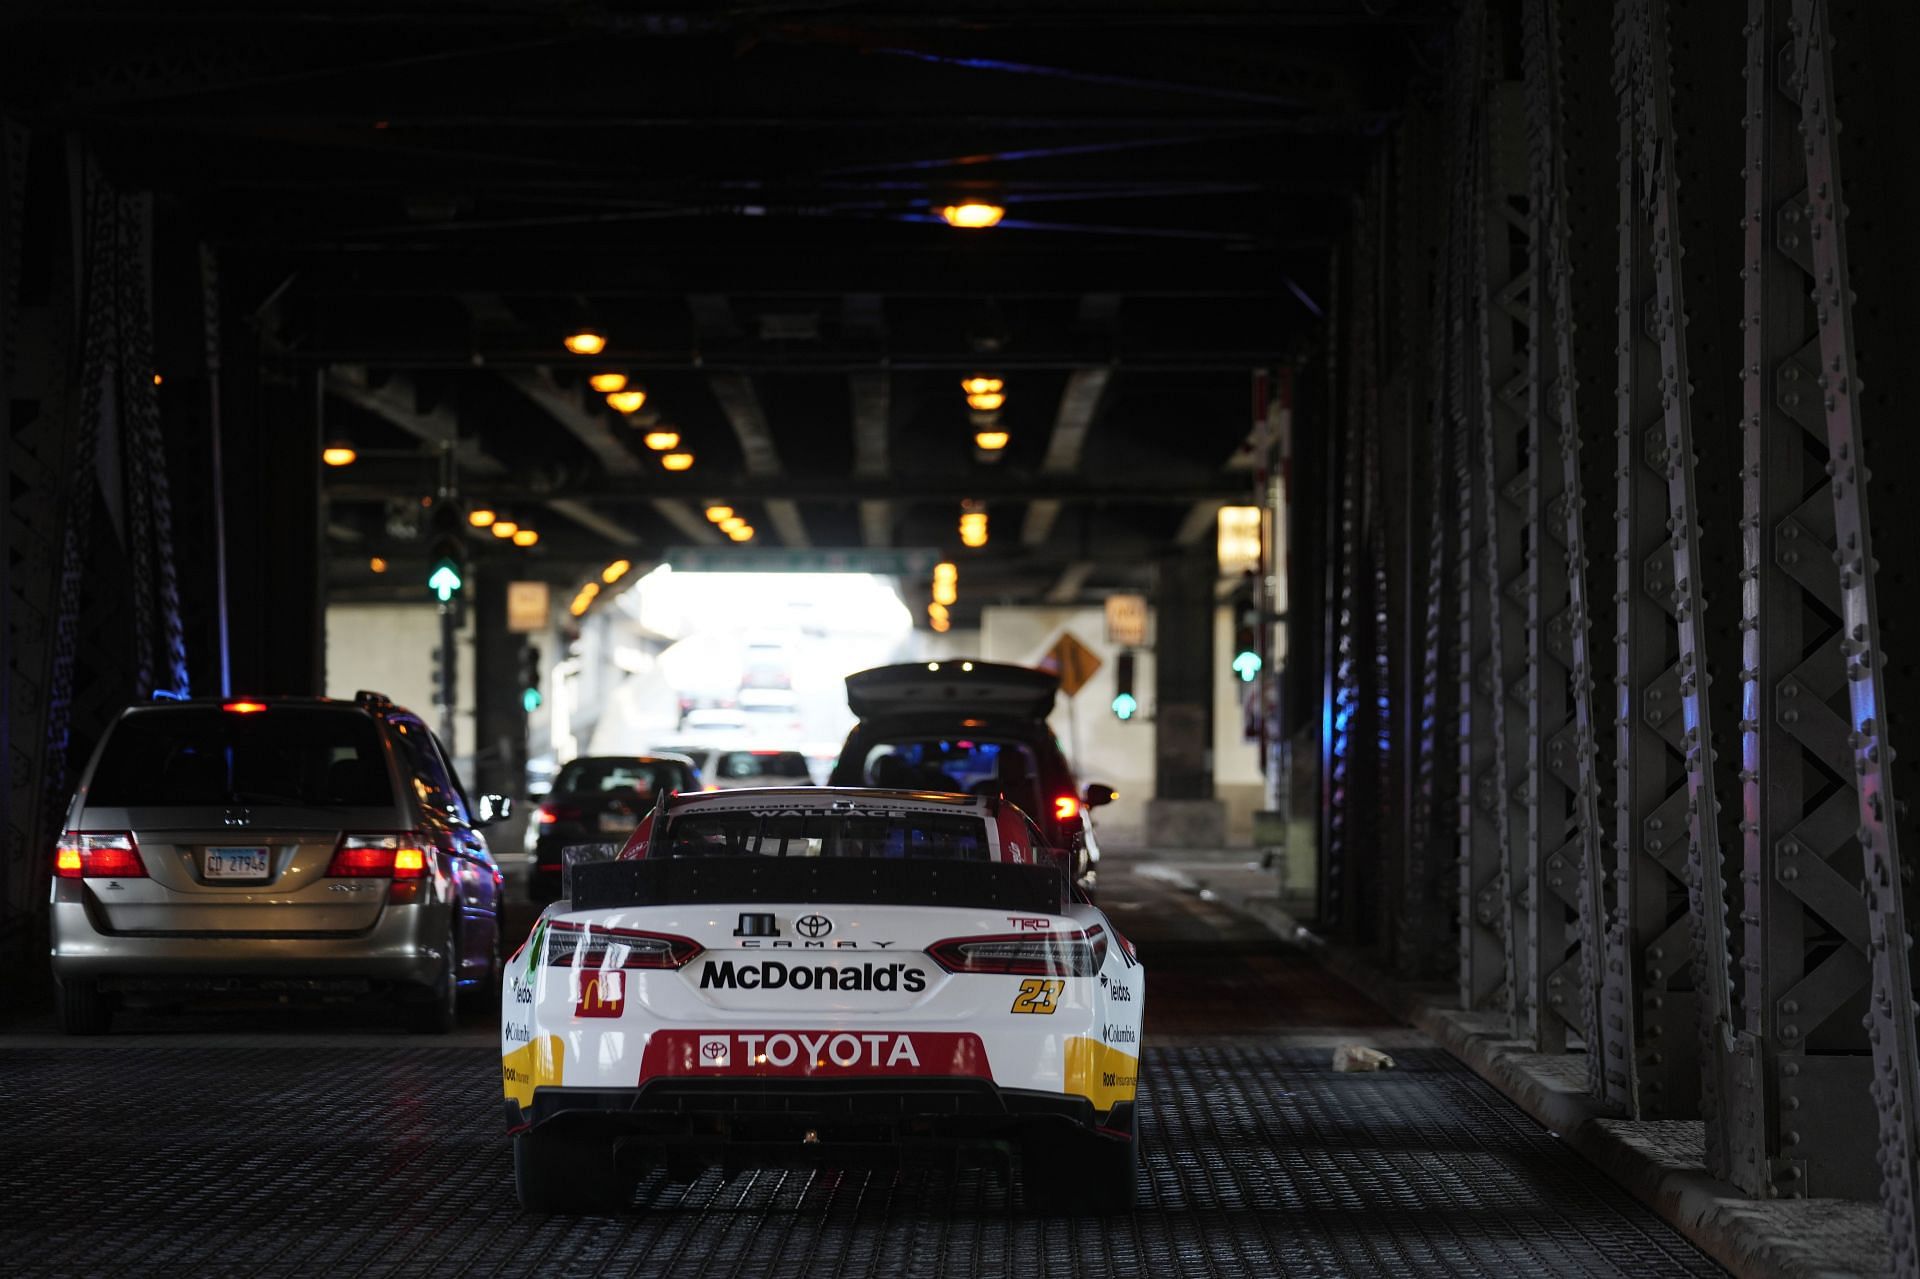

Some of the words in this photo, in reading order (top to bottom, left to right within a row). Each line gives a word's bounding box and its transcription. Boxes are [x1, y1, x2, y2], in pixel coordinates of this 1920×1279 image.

[750, 809, 907, 818] WALLACE
[207, 856, 223, 872] CD
[1006, 916, 1050, 931] TRD
[741, 940, 896, 949] CAMRY
[699, 960, 926, 993] McDonald's
[1010, 979, 1065, 1015] 23
[1109, 979, 1131, 1003] leidos
[1107, 1023, 1136, 1043] Columbia
[737, 1033, 921, 1068] TOYOTA
[1103, 1071, 1116, 1087] Root
